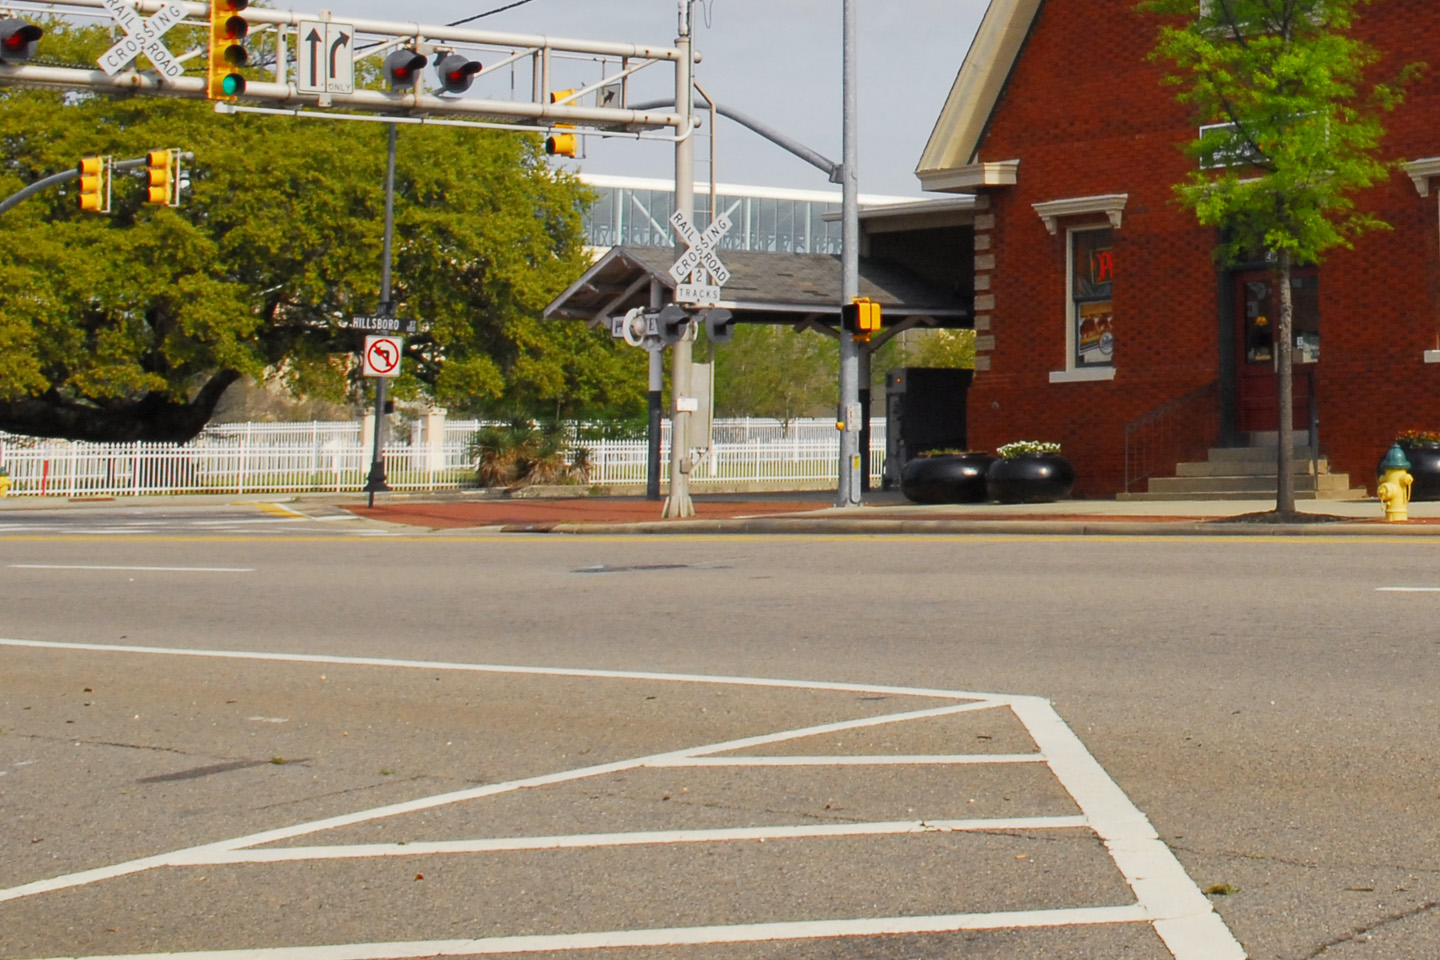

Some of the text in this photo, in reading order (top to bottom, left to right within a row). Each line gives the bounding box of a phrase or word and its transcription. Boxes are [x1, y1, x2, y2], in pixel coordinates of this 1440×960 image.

[106, 6, 181, 67] CROSSING
[147, 43, 178, 77] ROAD
[328, 83, 351, 91] ONLY
[673, 213, 727, 282] RAIL ROAD
[675, 220, 727, 276] CROSSING
[696, 269, 703, 283] 2
[680, 288, 718, 300] TRACKS
[352, 316, 400, 331] HILLSBORO
